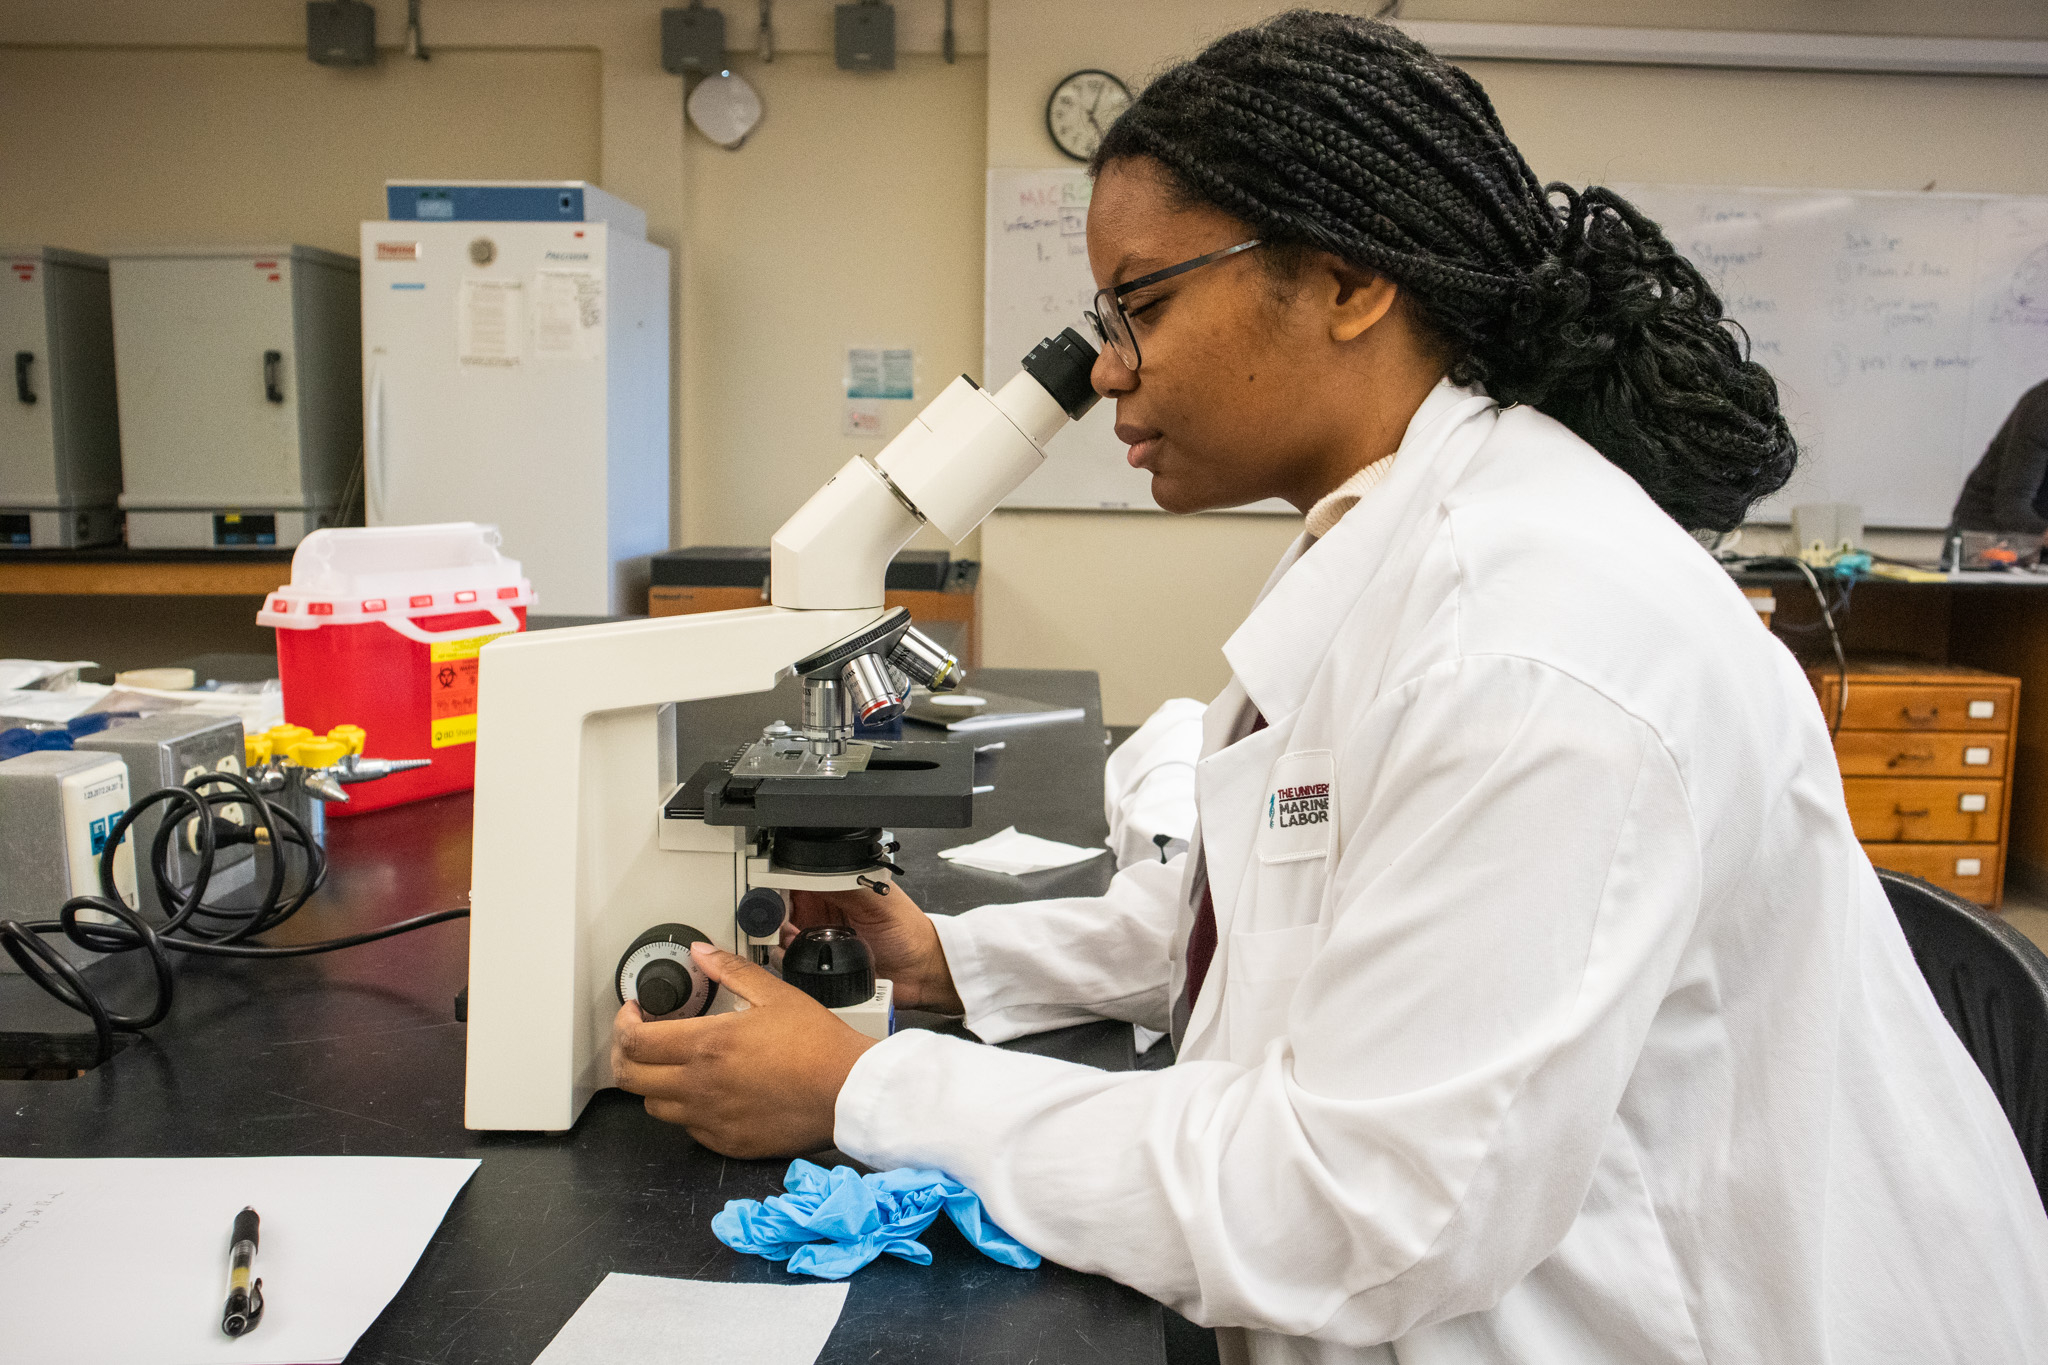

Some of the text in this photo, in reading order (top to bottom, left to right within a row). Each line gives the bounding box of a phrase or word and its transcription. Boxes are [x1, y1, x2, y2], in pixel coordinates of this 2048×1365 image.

[1277, 787, 1294, 799] THE
[1279, 798, 1329, 815] MARINE
[1279, 811, 1329, 828] LABOR
